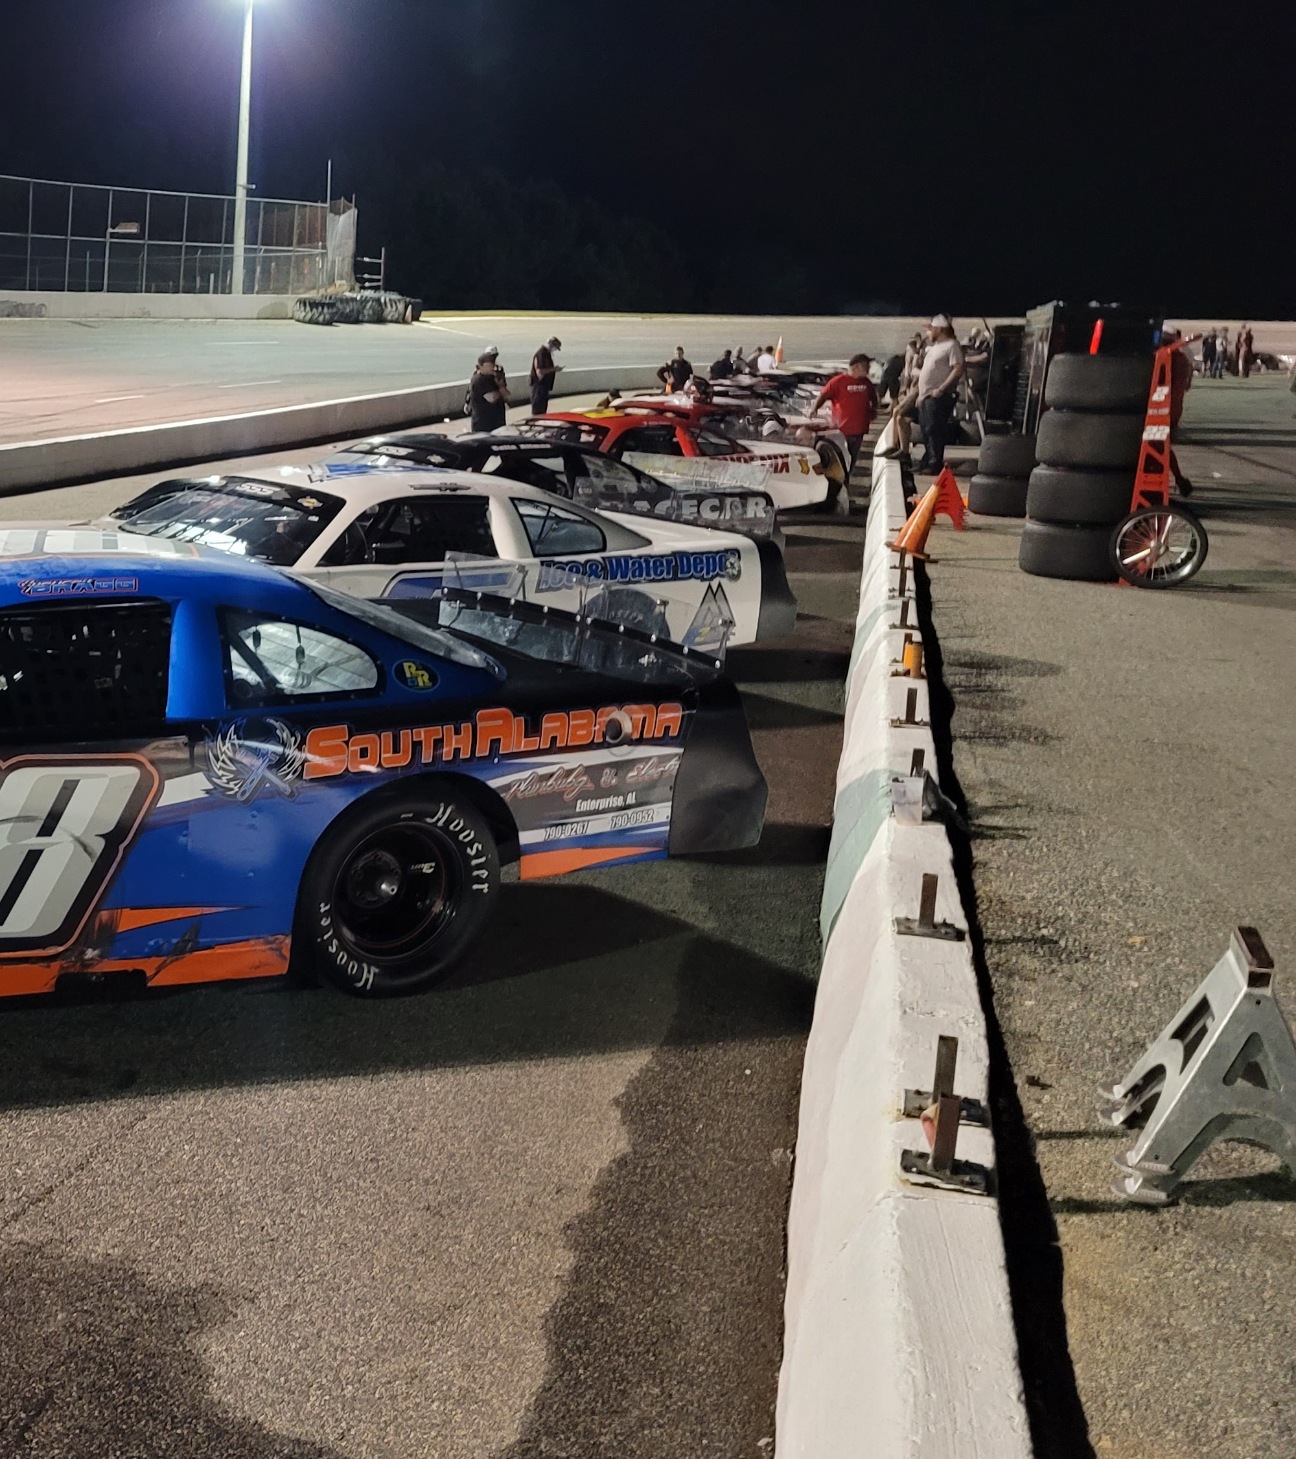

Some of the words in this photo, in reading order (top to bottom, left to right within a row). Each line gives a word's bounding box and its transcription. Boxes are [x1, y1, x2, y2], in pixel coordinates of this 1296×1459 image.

[606, 555, 675, 583] Water
[677, 549, 739, 579] Depo
[576, 795, 625, 813] Enterprise,
[626, 792, 637, 806] AL
[610, 809, 655, 829] 790-0952
[425, 802, 491, 894] Hoosier
[317, 902, 380, 990] Hoosier
